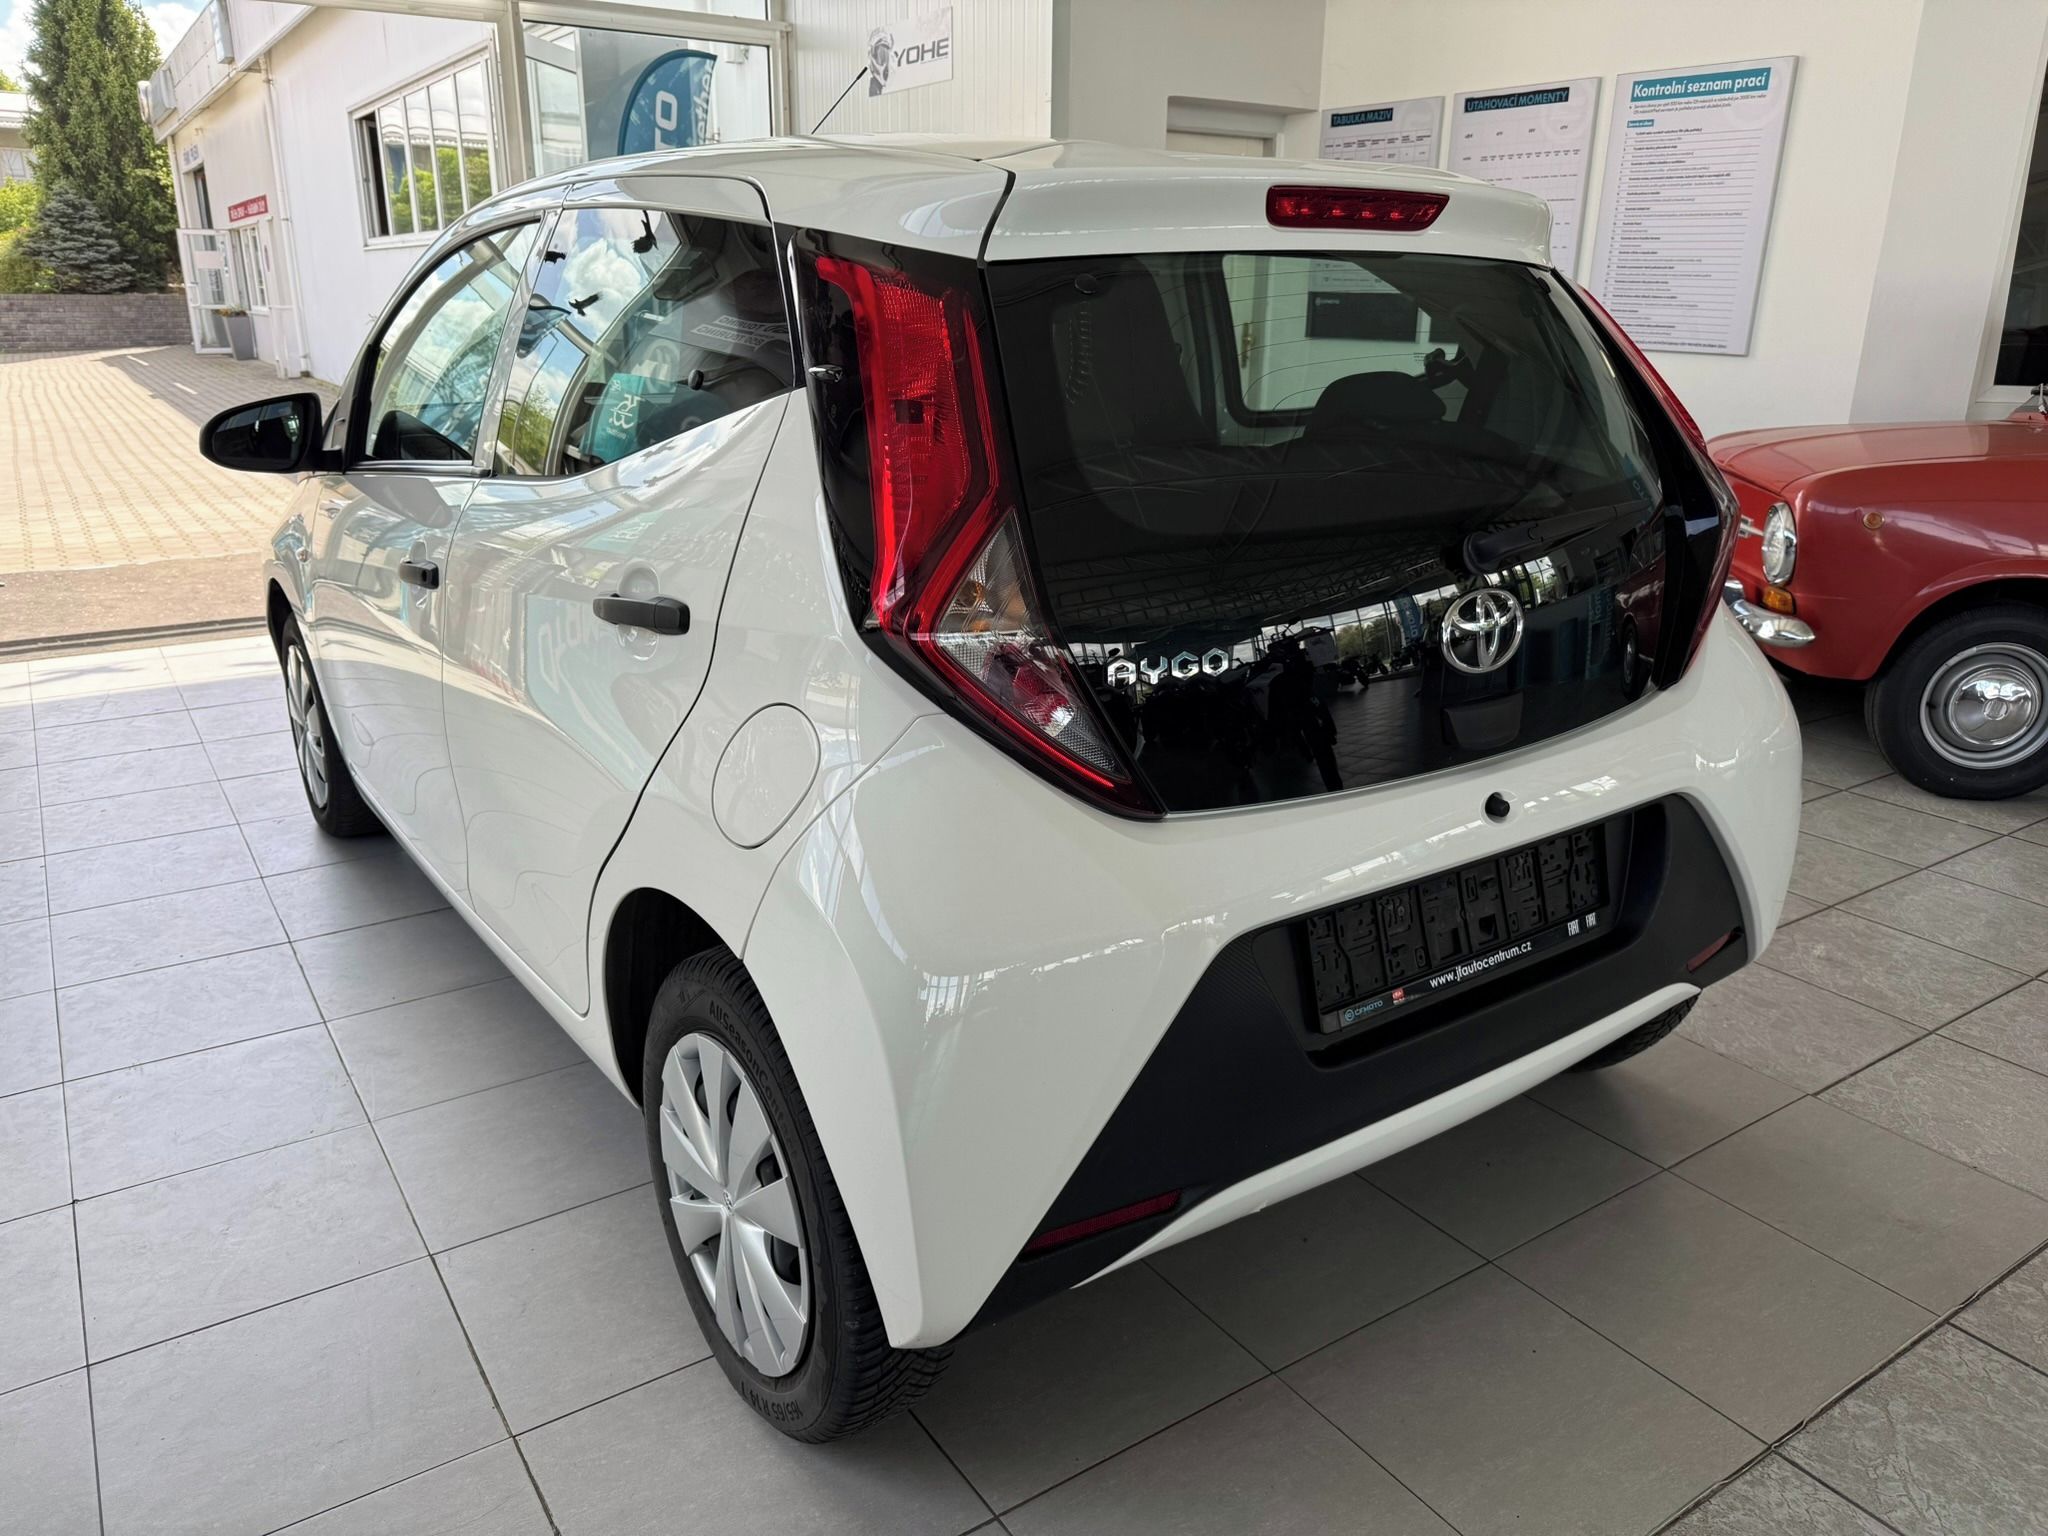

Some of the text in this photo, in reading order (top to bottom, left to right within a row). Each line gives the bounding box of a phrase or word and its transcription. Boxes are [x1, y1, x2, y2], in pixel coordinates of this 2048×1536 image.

[893, 36, 949, 68] YOHE
[1633, 71, 1767, 98] Kontrolní seznam prací
[1333, 109, 1392, 125] TABULKA MAZIV
[1467, 90, 1568, 112] UTAHOVACÍ MOMENTY
[1107, 647, 1230, 687] AYGO
[1429, 941, 1532, 989] www.jfautocentrum.cz
[708, 999, 797, 1159] AllSeasonCont
